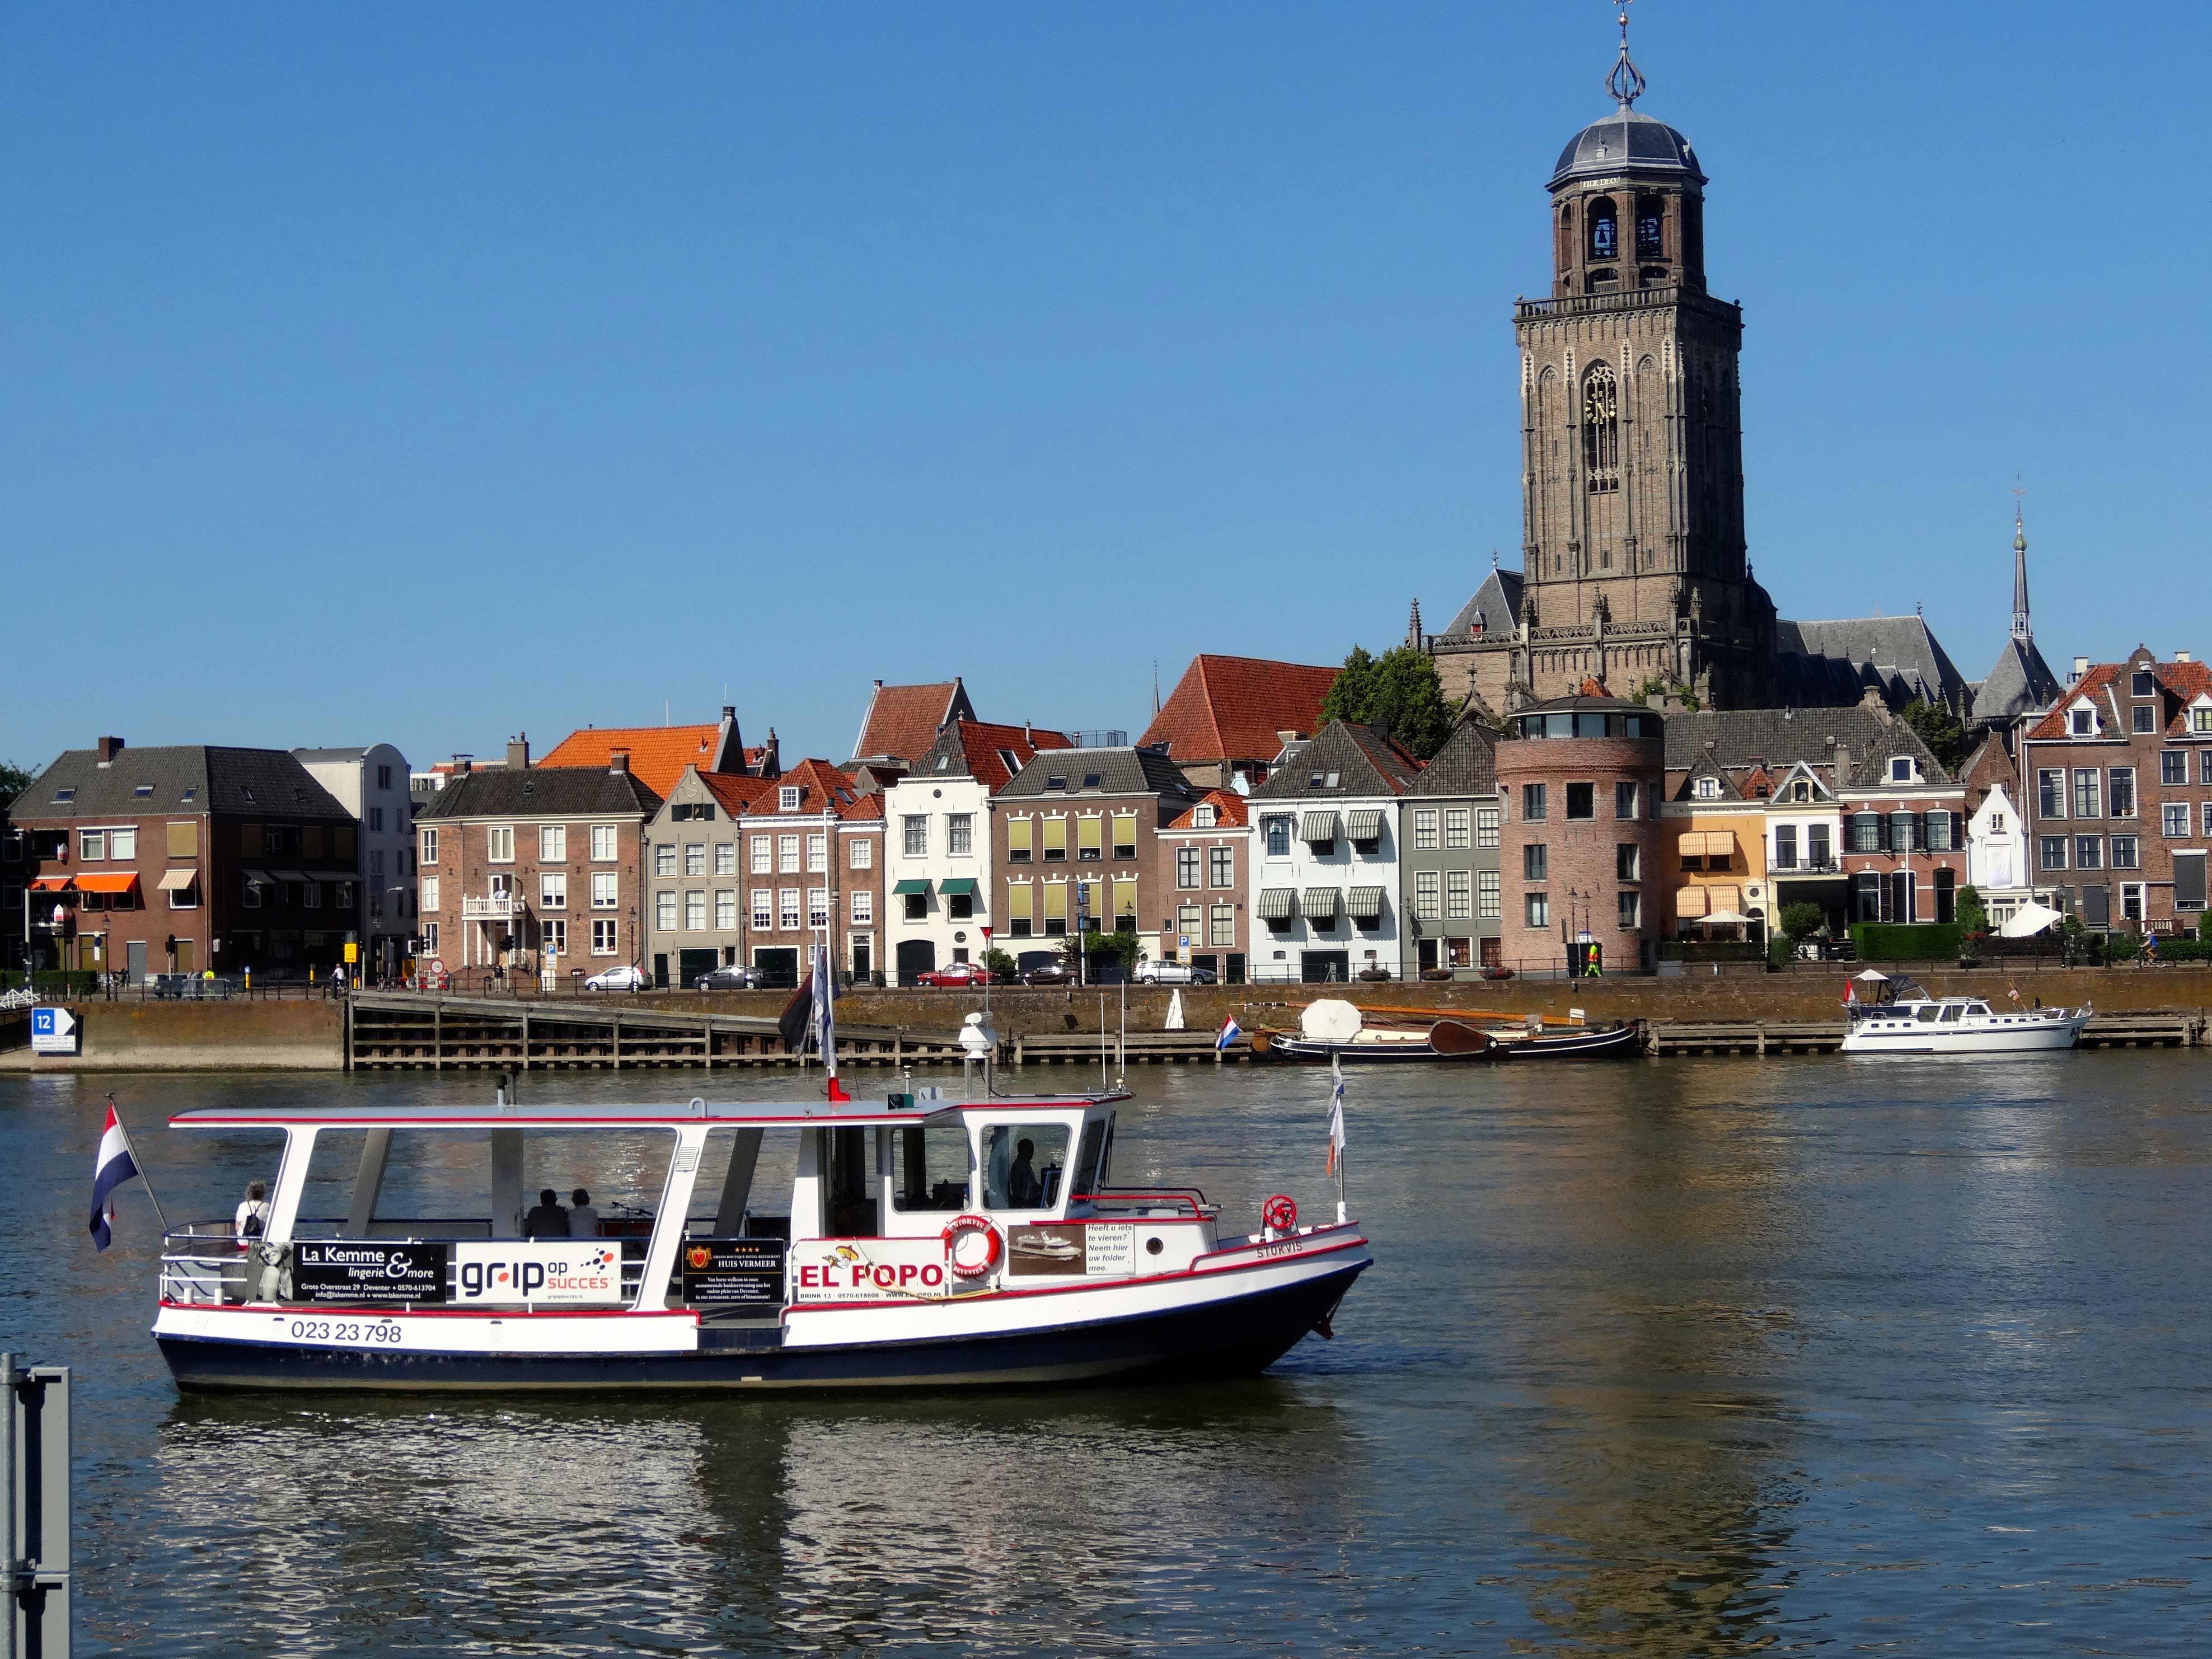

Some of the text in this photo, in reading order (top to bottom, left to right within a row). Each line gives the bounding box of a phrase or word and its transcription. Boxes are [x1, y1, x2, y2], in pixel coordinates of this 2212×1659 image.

[1583, 178, 1618, 187] FIDE DEO.
[548, 945, 554, 953] P
[1181, 937, 1187, 946] P
[37, 1016, 51, 1029] 12
[302, 1246, 384, 1263] La Kemme
[1256, 1241, 1303, 1258] STOKVIS
[348, 1267, 384, 1279] lingerie
[386, 1252, 412, 1278] &
[548, 1262, 568, 1276] op
[462, 1262, 544, 1297] grip
[548, 1278, 608, 1289] SUCCES
[801, 1265, 943, 1288] EL POPO
[291, 1321, 402, 1343] 023 23 798
